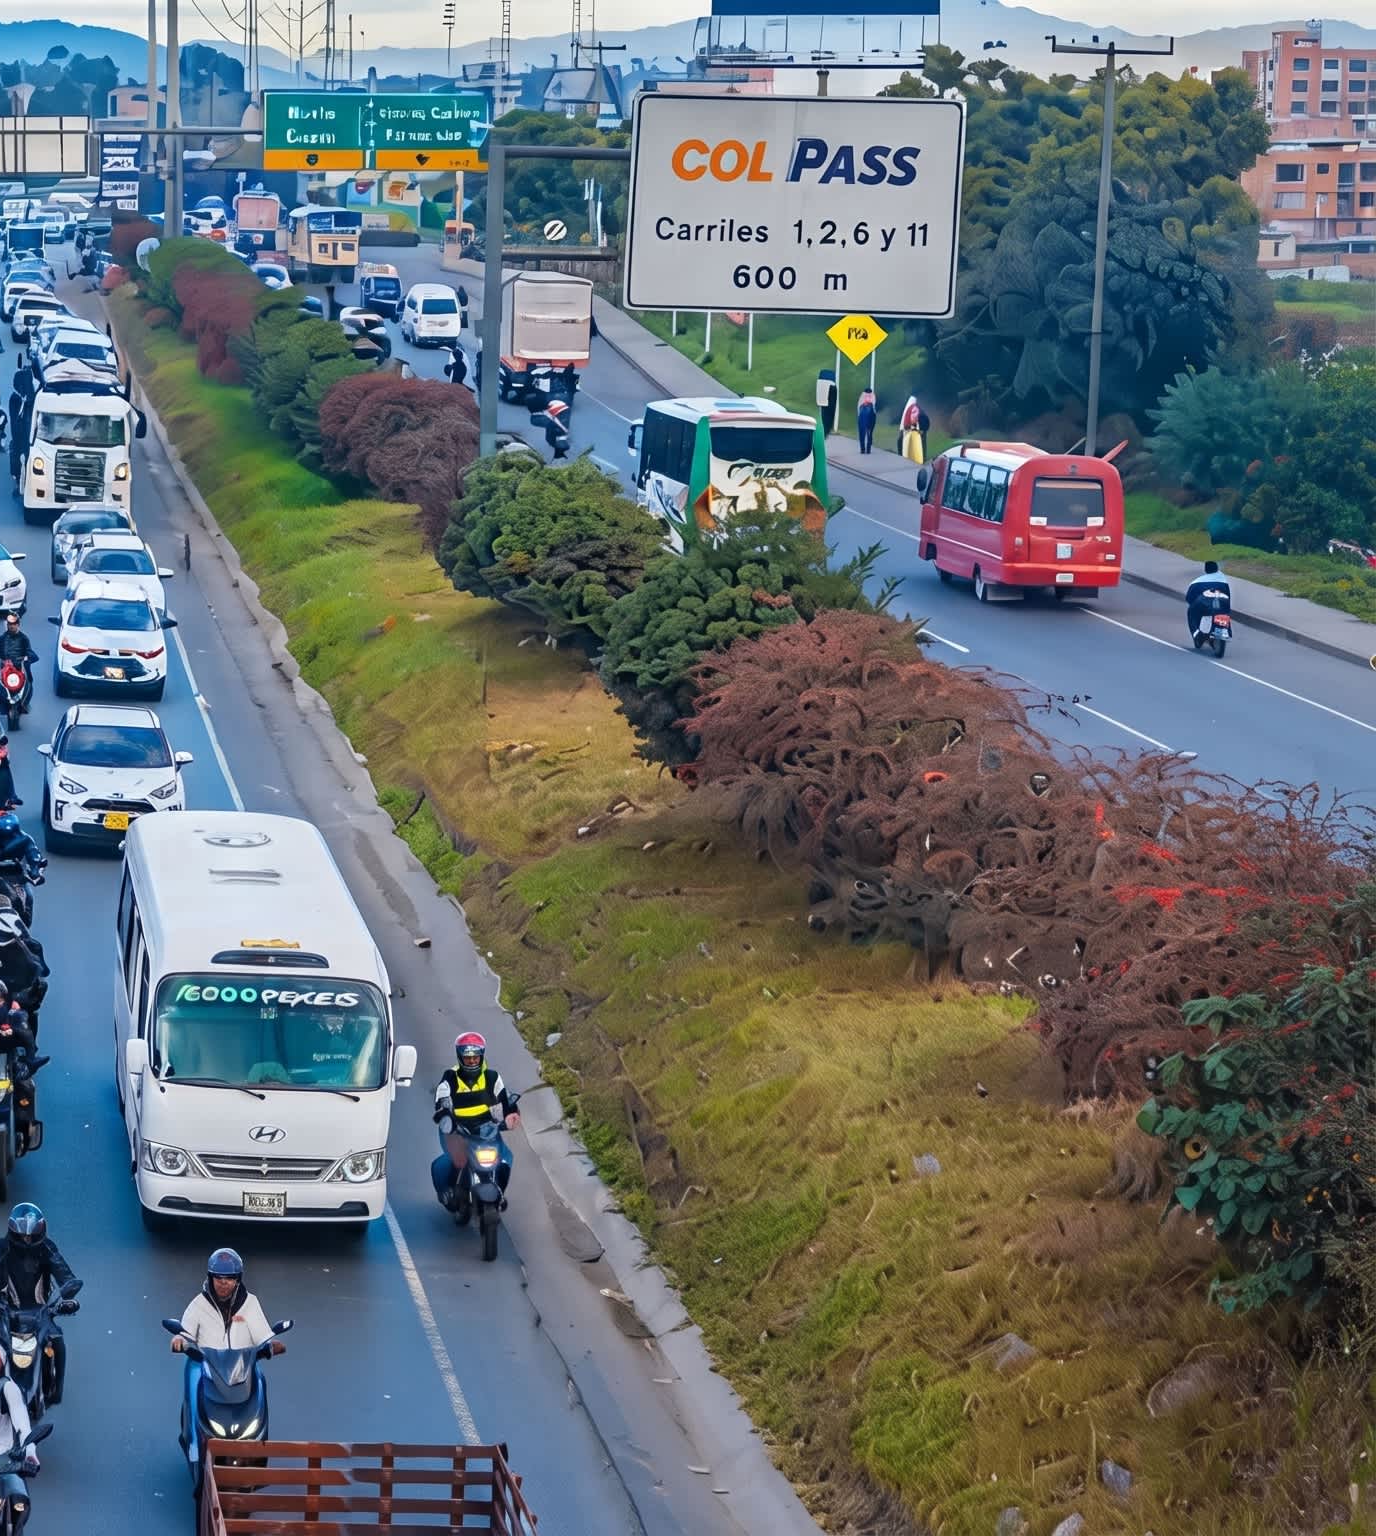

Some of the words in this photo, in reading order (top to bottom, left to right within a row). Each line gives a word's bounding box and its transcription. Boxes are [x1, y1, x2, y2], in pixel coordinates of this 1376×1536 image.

[671, 138, 773, 183] COL
[785, 137, 922, 187] PASS
[655, 216, 769, 243] Carriles
[880, 227, 897, 252] y
[907, 222, 928, 247] 11
[732, 264, 797, 290] 600
[823, 273, 848, 291] m
